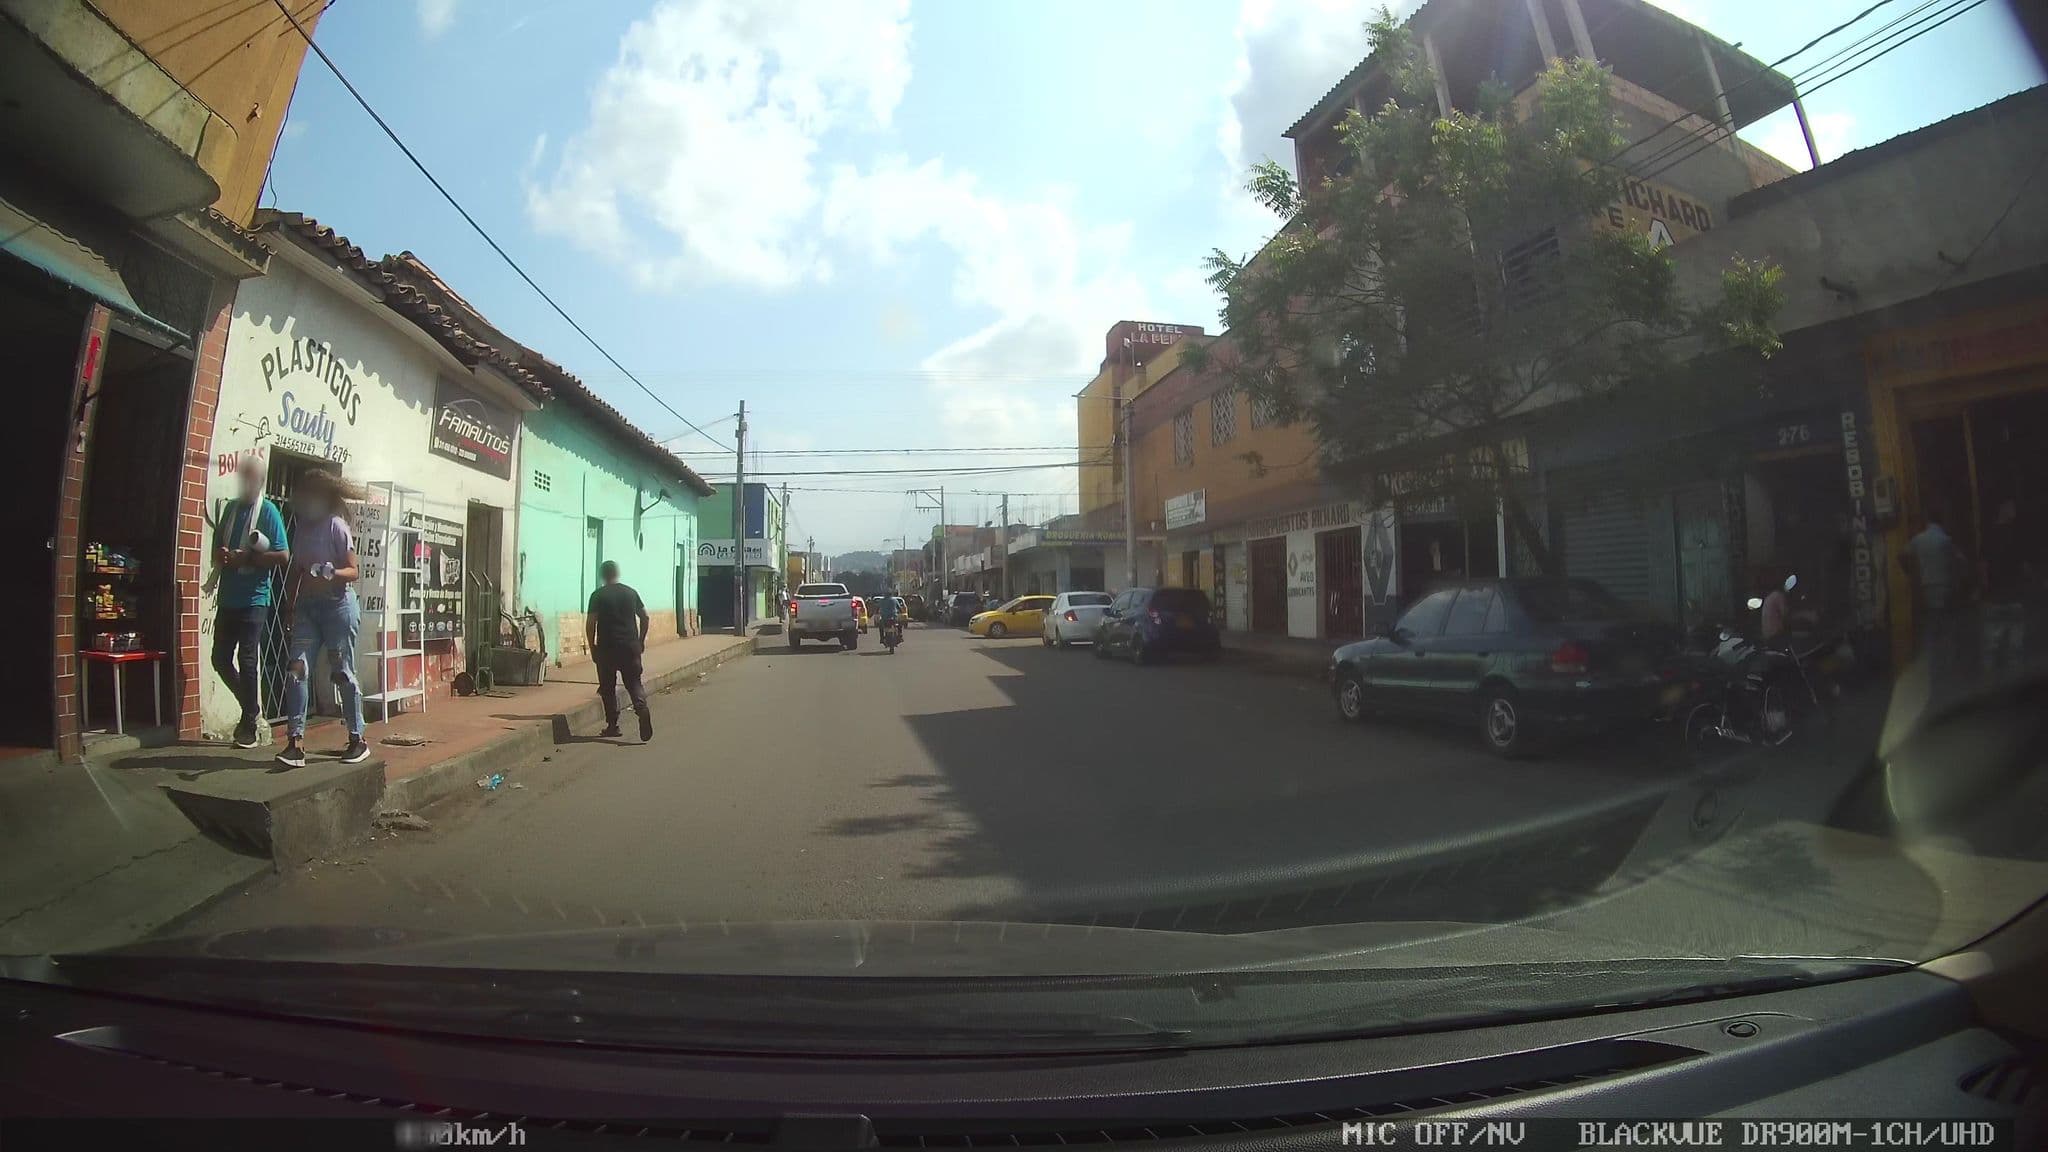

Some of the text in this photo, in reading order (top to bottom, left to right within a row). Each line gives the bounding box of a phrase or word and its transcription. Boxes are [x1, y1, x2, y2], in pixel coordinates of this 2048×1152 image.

[1623, 180, 1712, 232] ICHARD
[1131, 332, 1149, 343] LA
[1138, 323, 1183, 334] HOTEL
[261, 338, 361, 426] PLASTICOS
[278, 391, 335, 458] Santy
[439, 408, 511, 456] FAMAUTOS
[218, 447, 268, 476] BOLAS
